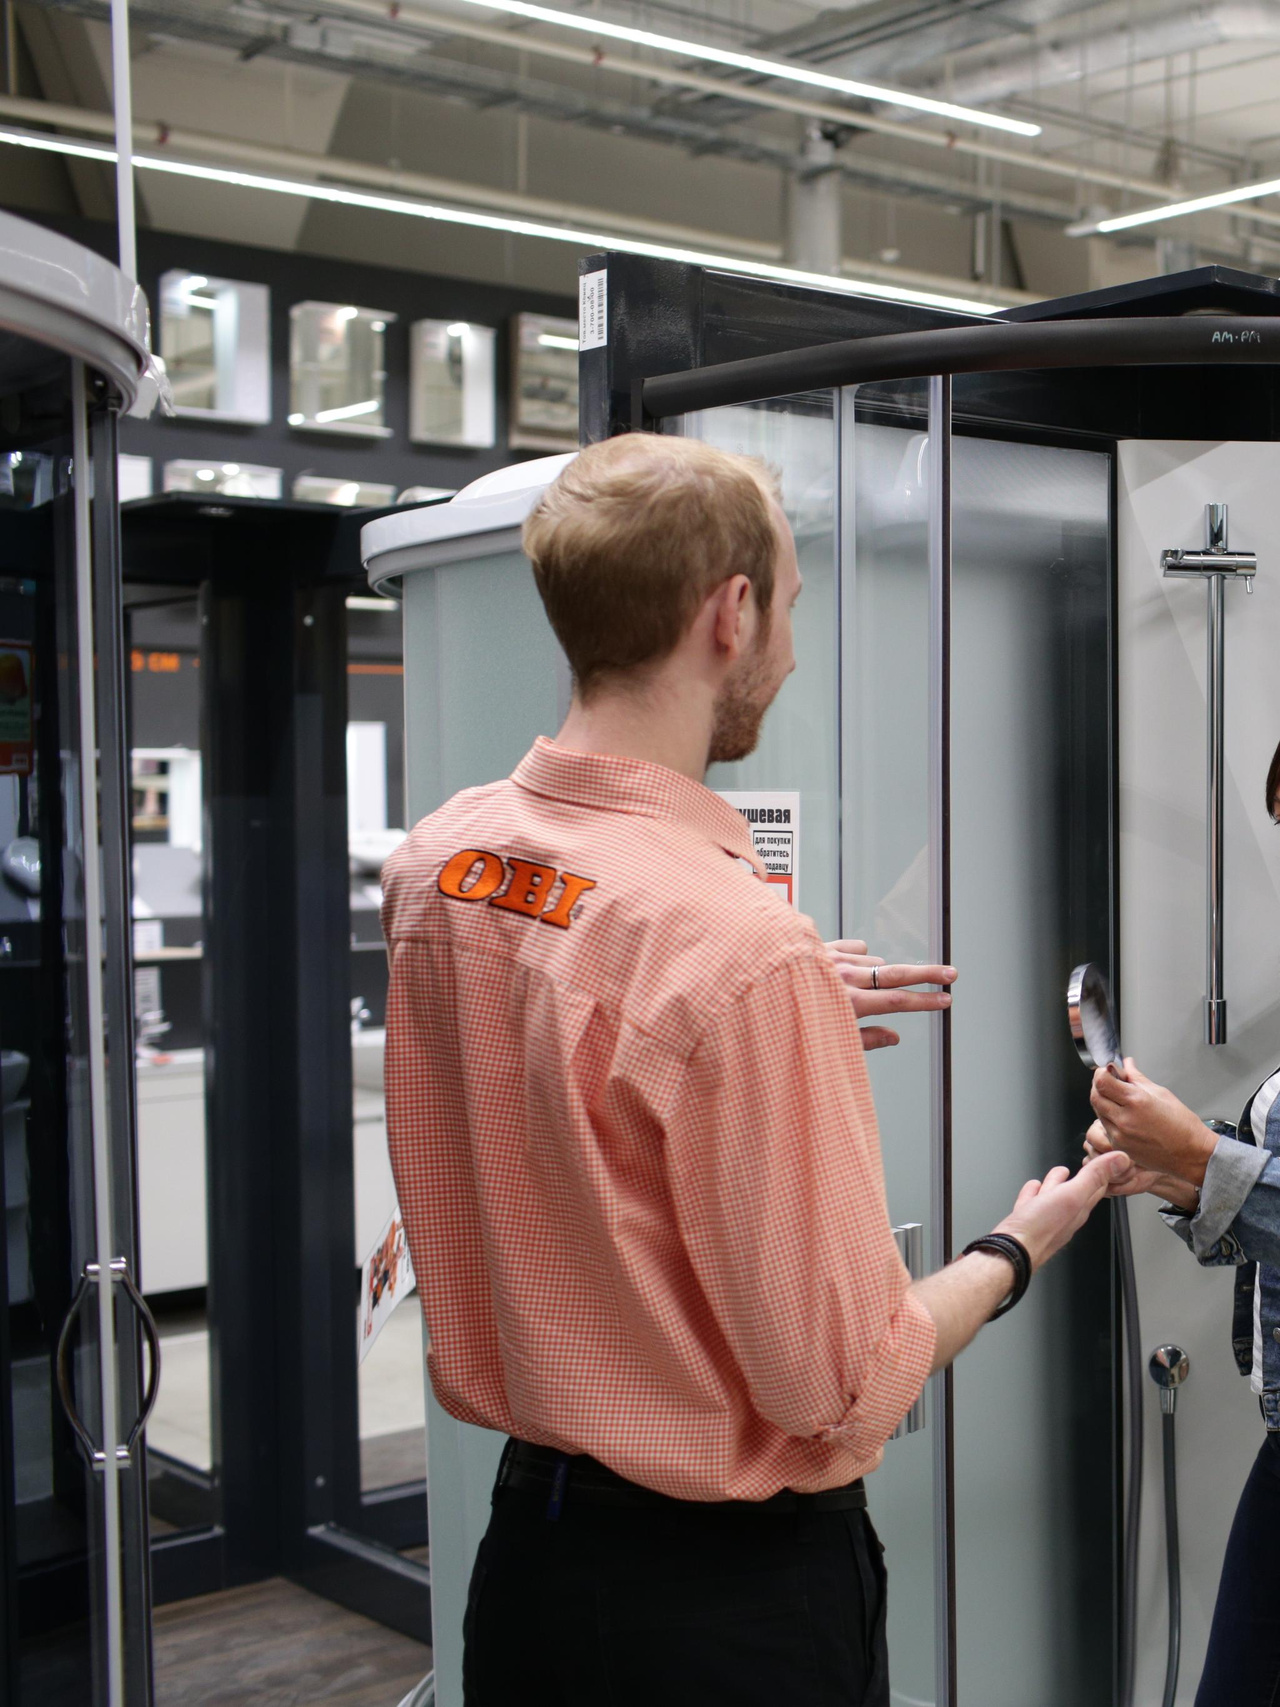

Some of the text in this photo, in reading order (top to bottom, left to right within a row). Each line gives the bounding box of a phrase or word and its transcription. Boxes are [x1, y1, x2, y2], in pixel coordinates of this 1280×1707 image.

[755, 836, 791, 846] для покупки
[764, 863, 789, 872] родавцу
[437, 848, 598, 930] OBI
